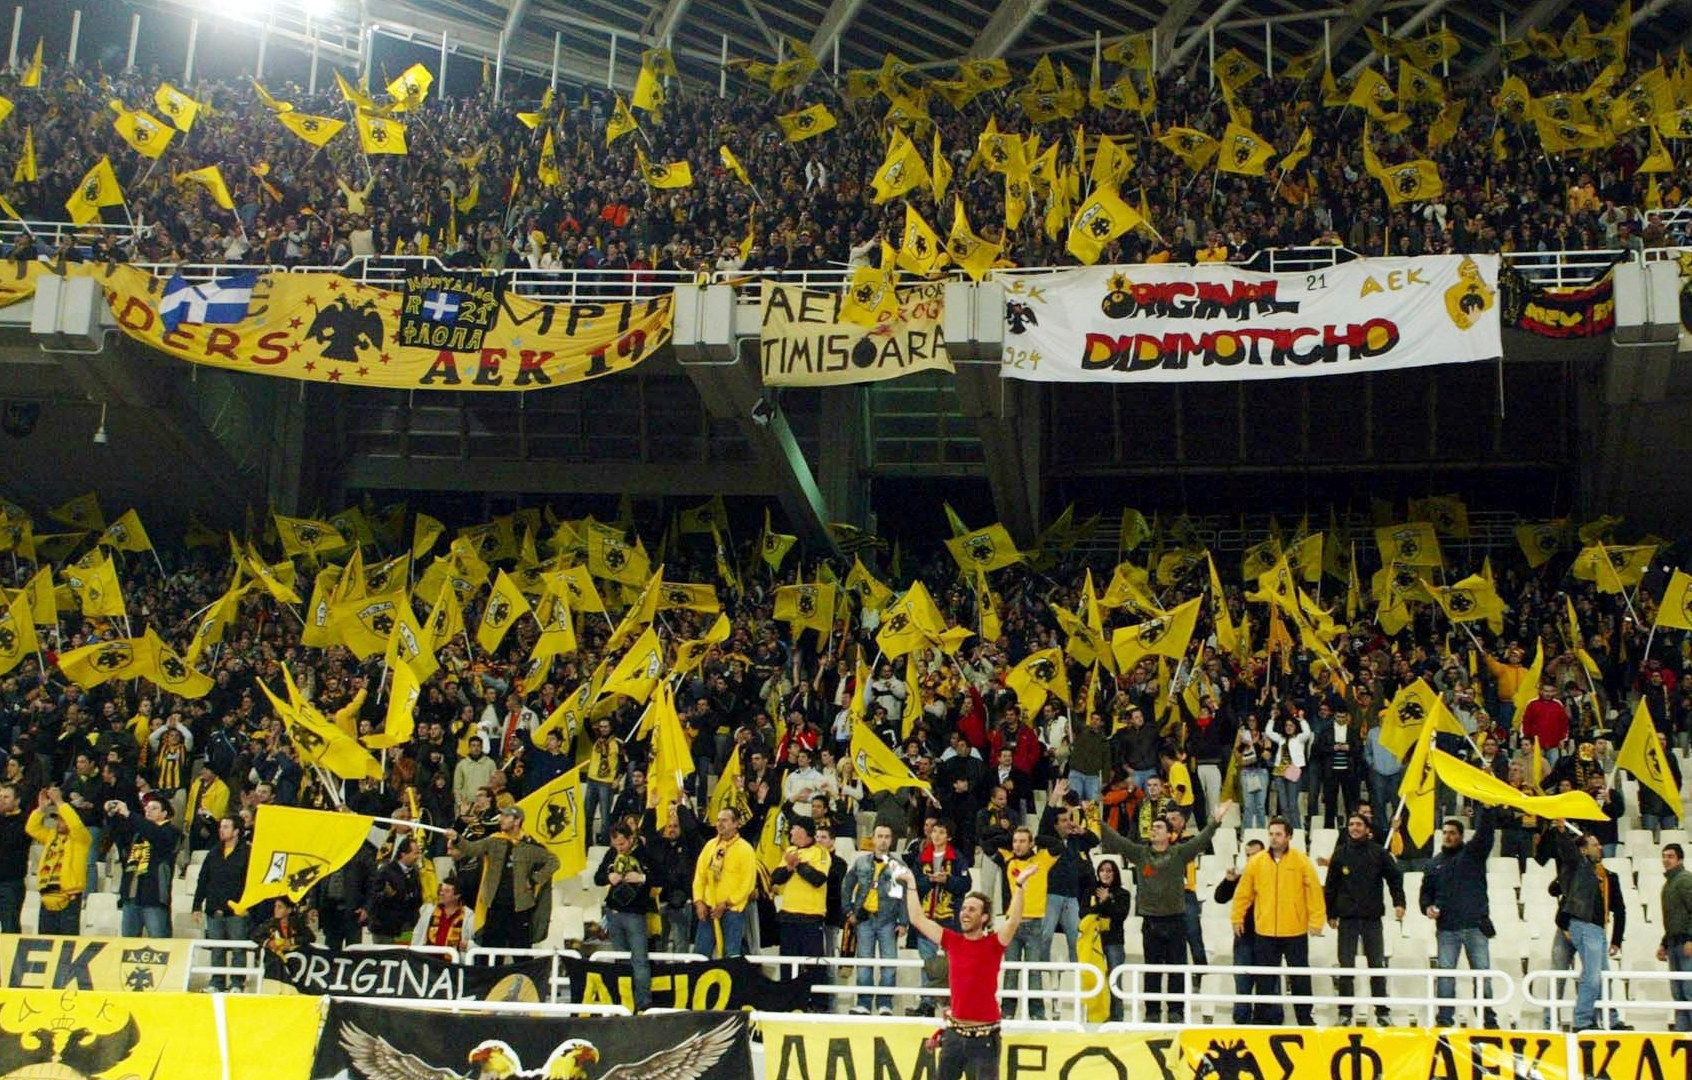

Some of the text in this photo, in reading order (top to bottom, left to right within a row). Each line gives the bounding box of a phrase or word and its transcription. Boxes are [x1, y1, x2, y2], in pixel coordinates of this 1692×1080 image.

[1004, 280, 1048, 304] EK
[1101, 279, 1300, 322] ORIGINAL
[1306, 273, 1327, 291] 21
[458, 301, 488, 325] 21
[762, 324, 949, 377] TIMISOARA
[1081, 317, 1401, 372] DIDIMOTICHO
[283, 951, 478, 1001] ORIGINAL
